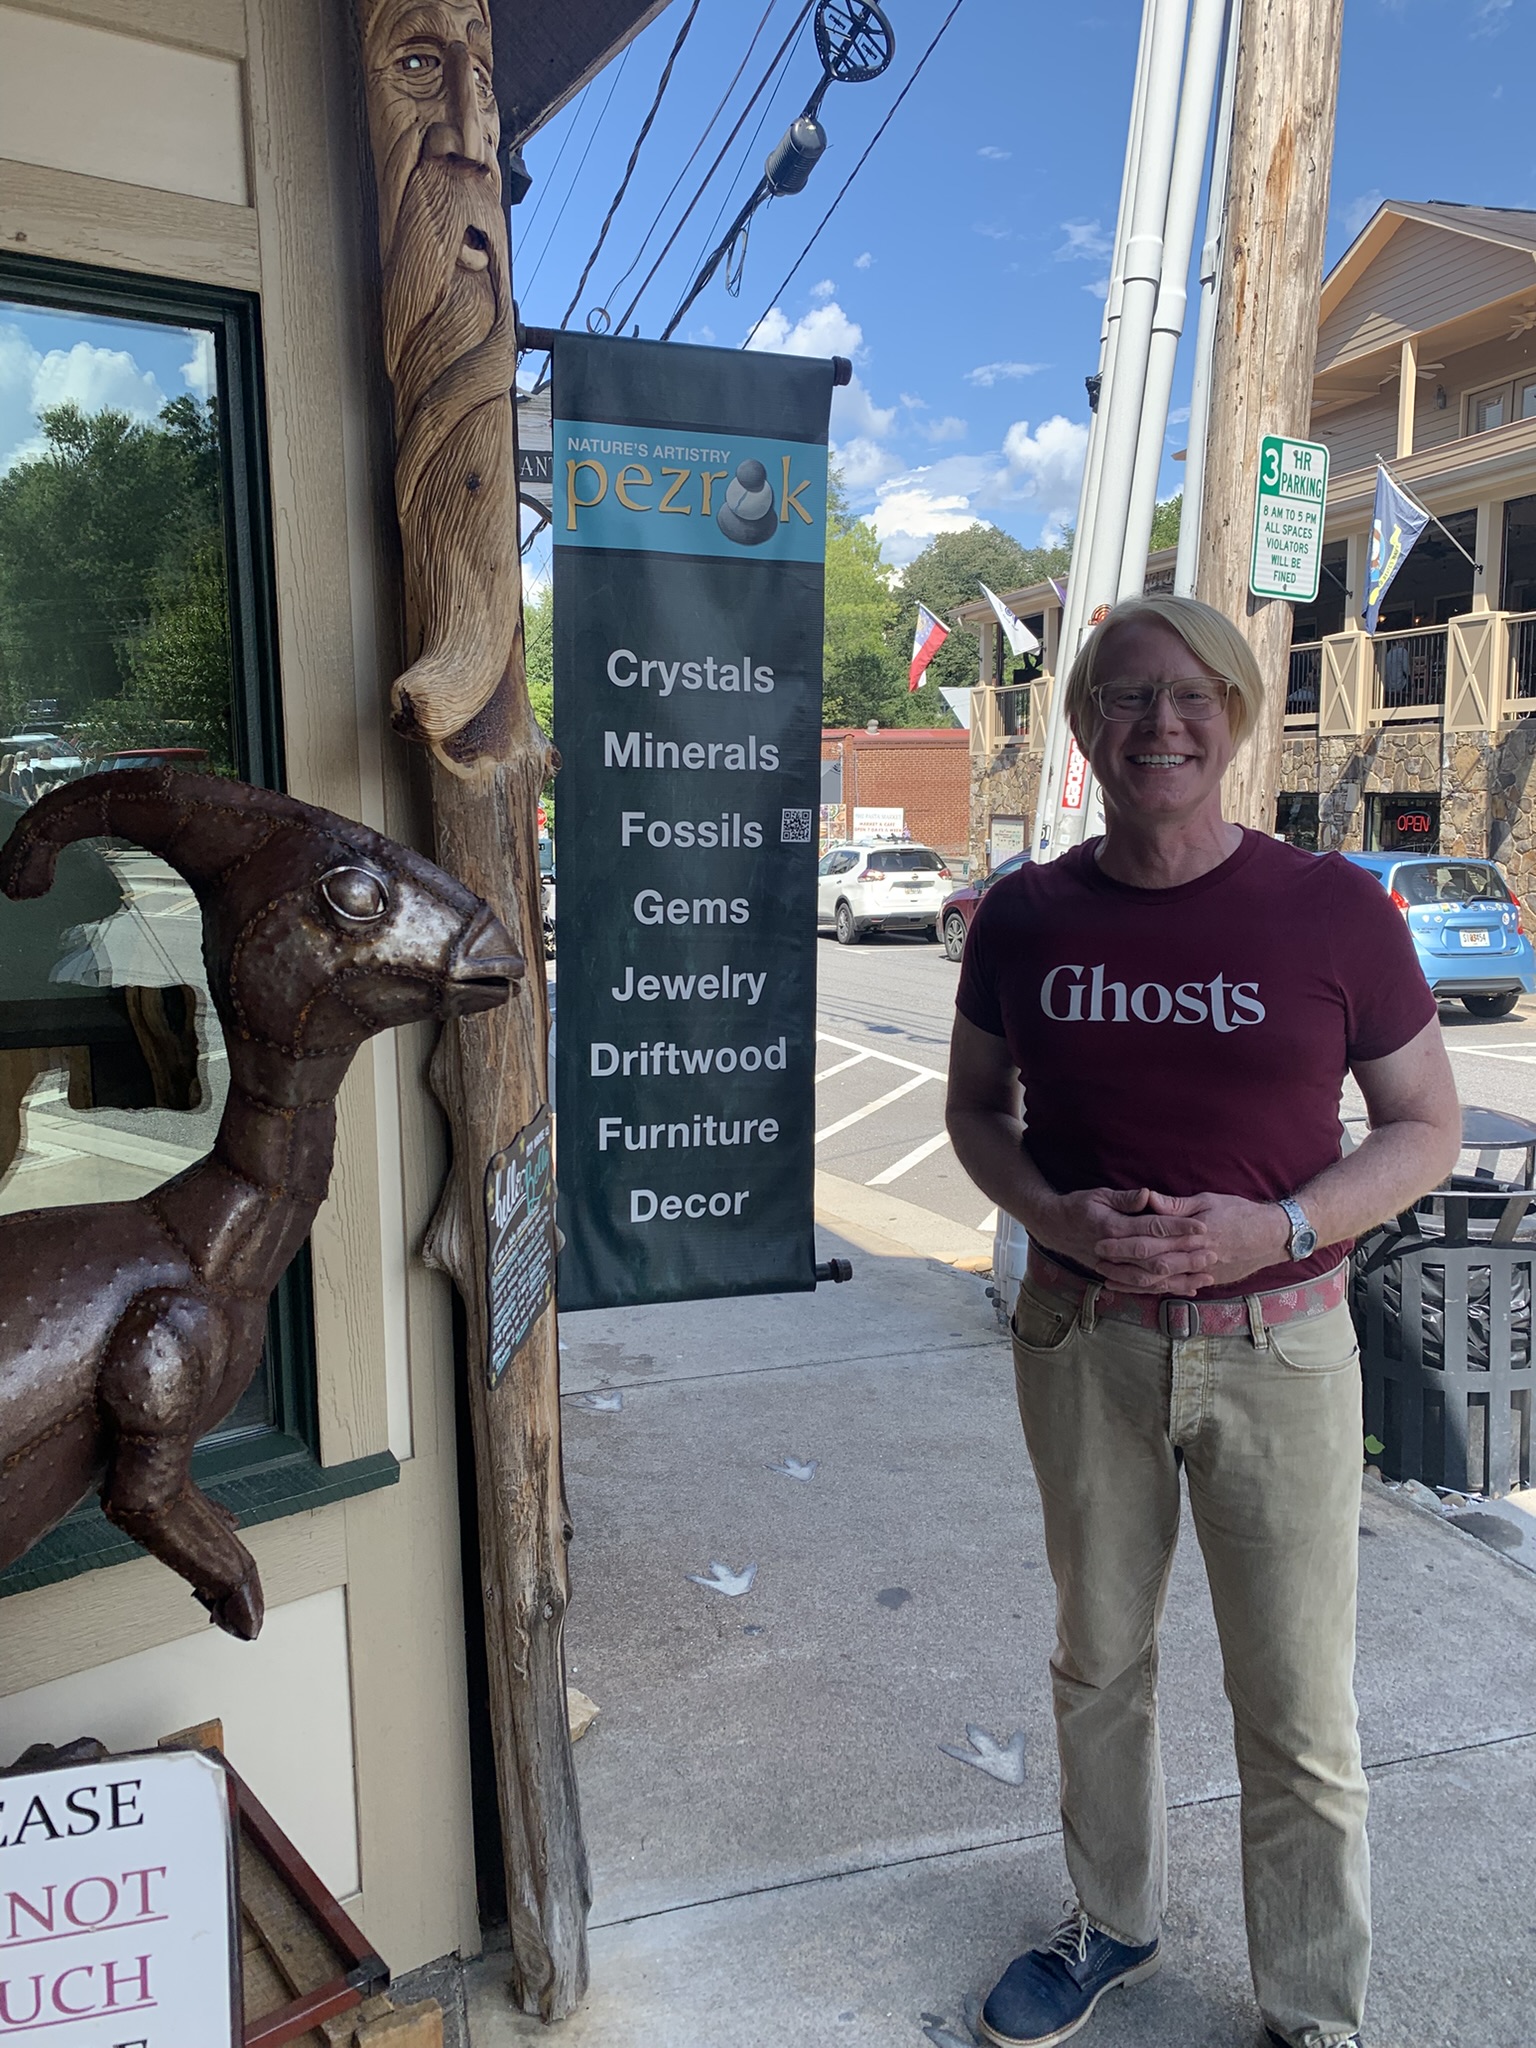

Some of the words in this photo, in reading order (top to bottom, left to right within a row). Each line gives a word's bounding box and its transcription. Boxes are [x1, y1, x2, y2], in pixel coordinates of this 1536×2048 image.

[567, 437, 649, 458] NATURE'S
[653, 445, 731, 464] ARTISTRY
[1262, 447, 1280, 487] 3
[1294, 451, 1313, 472] HR
[1281, 472, 1322, 499] PARKING
[1263, 504, 1269, 517] 8
[1271, 506, 1284, 519] AM
[1286, 508, 1296, 521] TO
[1297, 511, 1303, 522] 5
[1305, 512, 1317, 525] PM
[1264, 521, 1280, 534] ALL
[1282, 524, 1313, 540] SPACES
[1266, 537, 1309, 555] VIOLATORS
[1271, 554, 1289, 568] WILL
[1291, 557, 1302, 569] BE
[1273, 570, 1297, 584] FINED
[606, 648, 775, 697] Crystals
[604, 731, 780, 772] Minerals
[621, 811, 763, 848] Fossils
[1397, 814, 1430, 832] OPEN
[633, 888, 750, 925] Gems
[611, 965, 767, 1005] Jewelry
[1040, 962, 1266, 1033] Ghosts
[590, 1036, 787, 1077] Driftwood
[598, 1114, 780, 1151] Furniture
[630, 1188, 750, 1223] Decor
[0, 1779, 144, 1849] ASE
[4, 1866, 167, 1939] NOT
[0, 1954, 153, 2025] UCH
